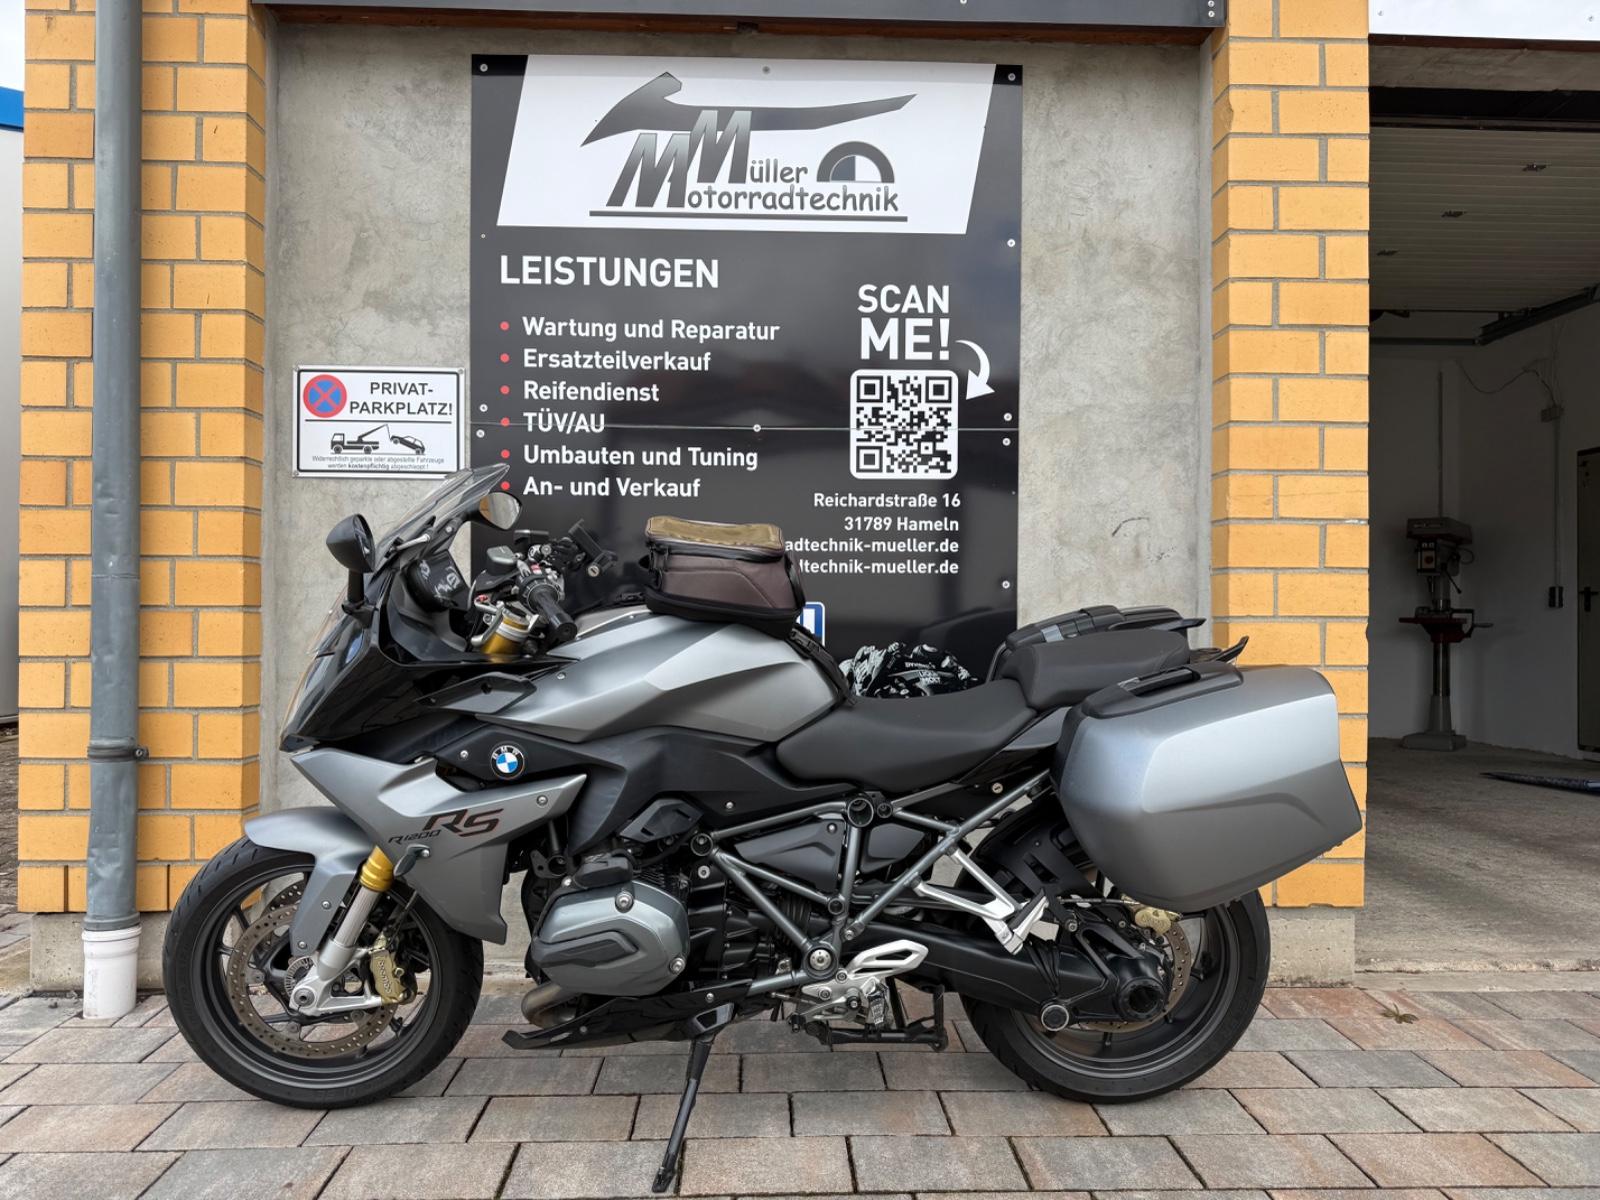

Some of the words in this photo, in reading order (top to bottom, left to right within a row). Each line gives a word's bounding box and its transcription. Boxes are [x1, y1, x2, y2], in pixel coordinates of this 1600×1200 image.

[696, 109, 809, 185] Müller
[605, 132, 900, 213] Motorradtechnik
[500, 254, 719, 289] LEISTUNGEN
[857, 283, 950, 314] SCAN
[522, 316, 617, 342] Wartung
[624, 318, 664, 339] und
[671, 319, 781, 344] Reparatur
[860, 317, 950, 361] ME!
[523, 348, 712, 371] Ersatzteilverkauf
[370, 381, 433, 396] PRIVAT-
[523, 380, 660, 402] Reifendienst
[349, 401, 453, 416] PARKPLATZ!
[523, 408, 605, 433] TÜV/AU
[523, 444, 635, 465] Umbauten
[641, 446, 681, 466] und
[687, 446, 758, 471] Tuning
[522, 476, 563, 496] An-
[570, 477, 610, 497] und
[616, 477, 701, 498] Verkauf
[813, 492, 937, 508] Reichardstraße
[942, 493, 961, 508] 16
[844, 516, 892, 531] 31789
[896, 516, 959, 531] Hameln
[785, 537, 959, 553] adtechnik-mueller.de
[387, 829, 442, 846] R1200
[422, 808, 505, 838] RS
